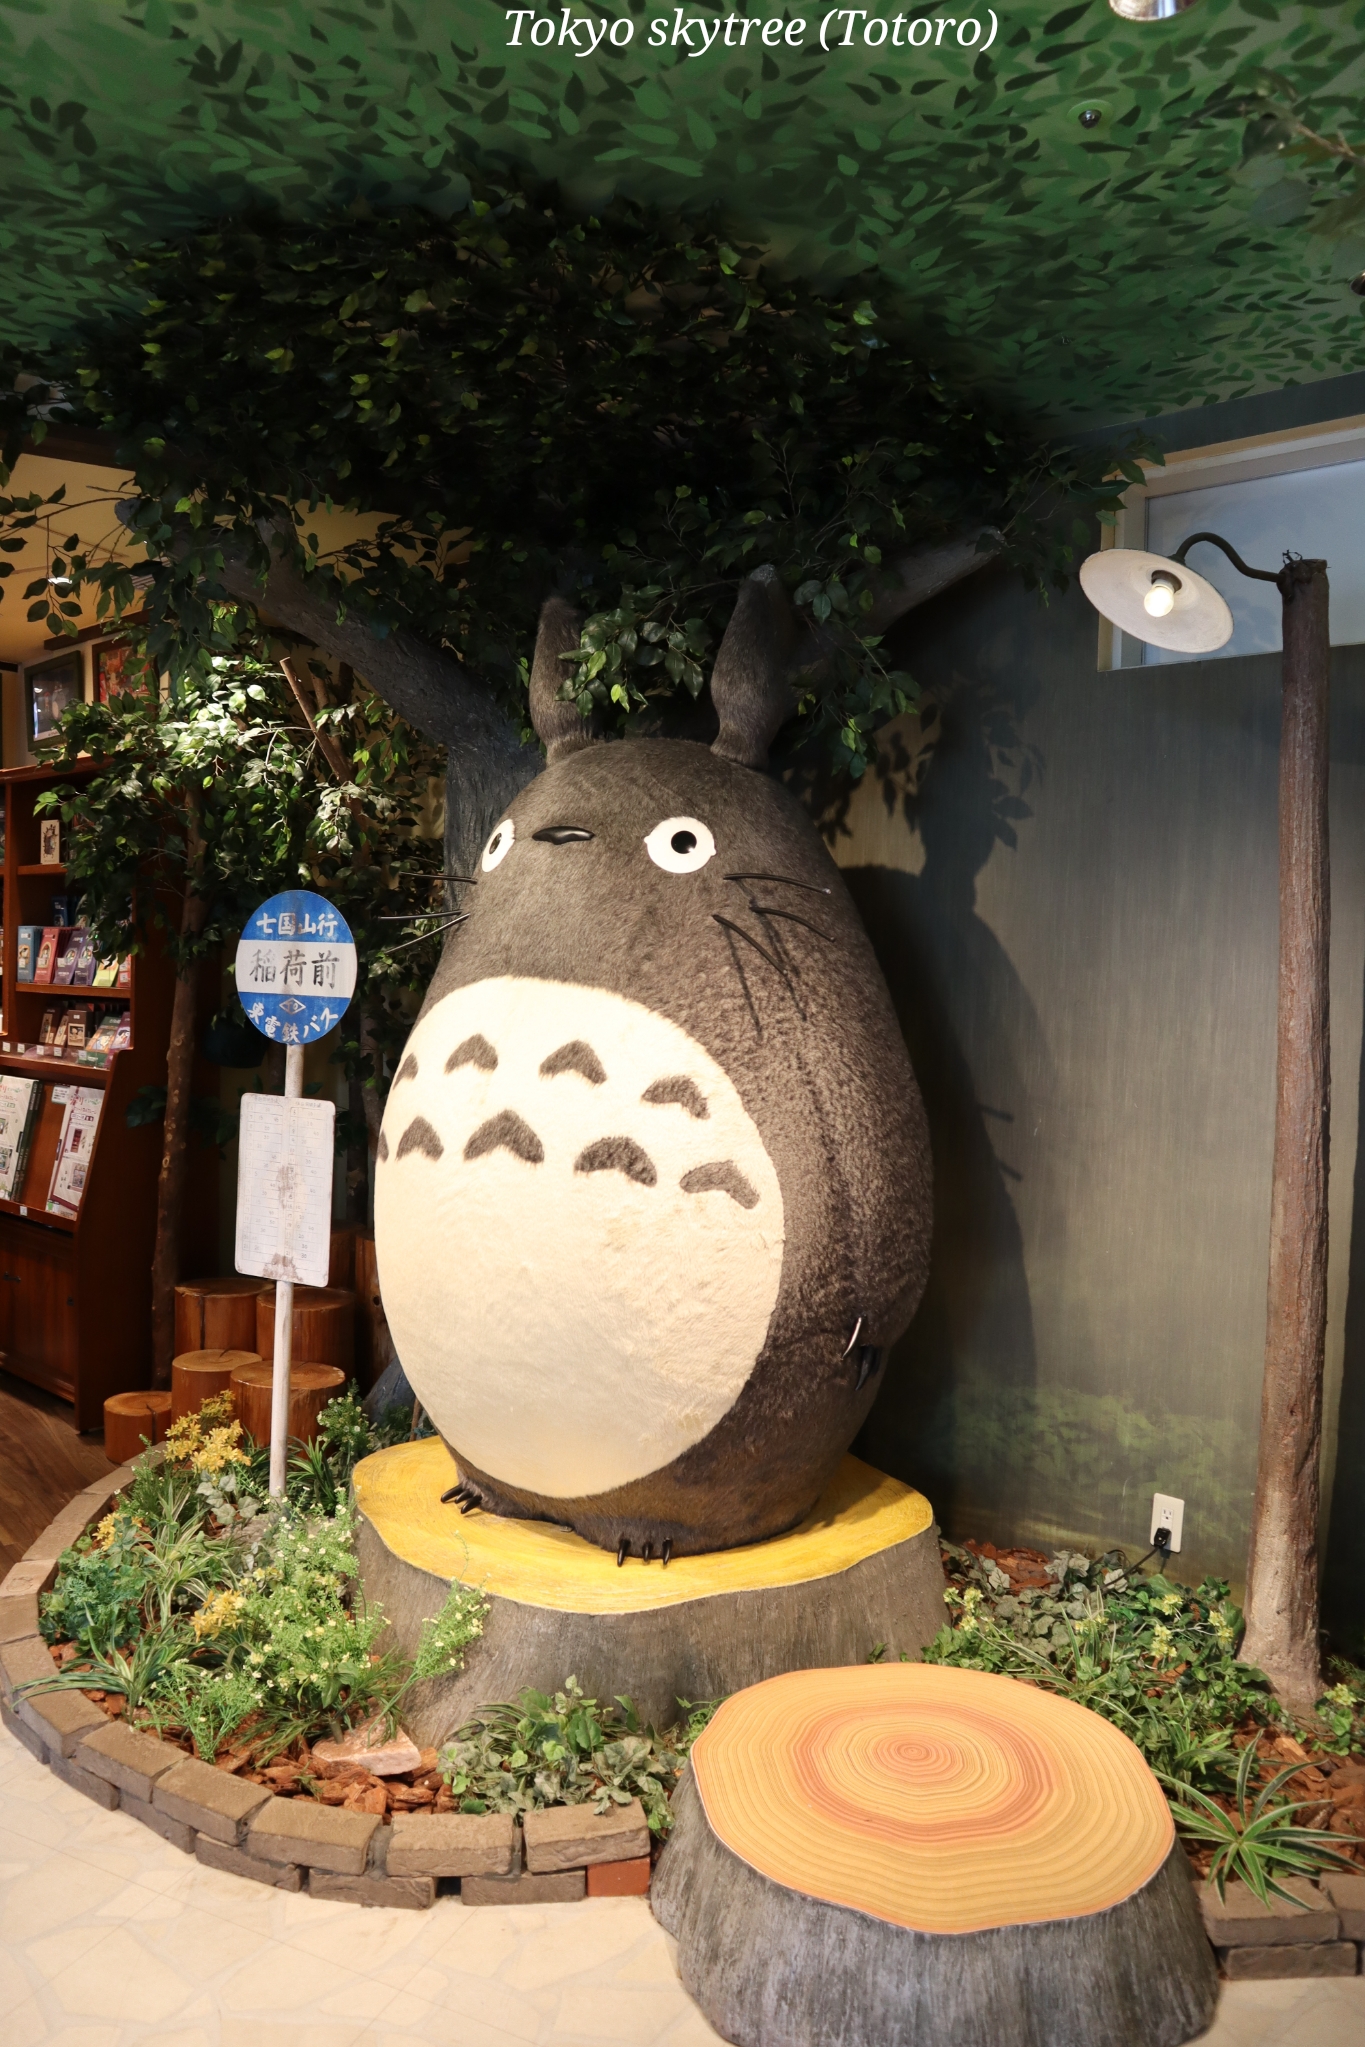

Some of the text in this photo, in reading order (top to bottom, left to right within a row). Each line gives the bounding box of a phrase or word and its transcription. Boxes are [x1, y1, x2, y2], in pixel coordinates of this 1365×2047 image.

[256, 912, 338, 937] 七国山行
[249, 949, 340, 989] 稲荷前
